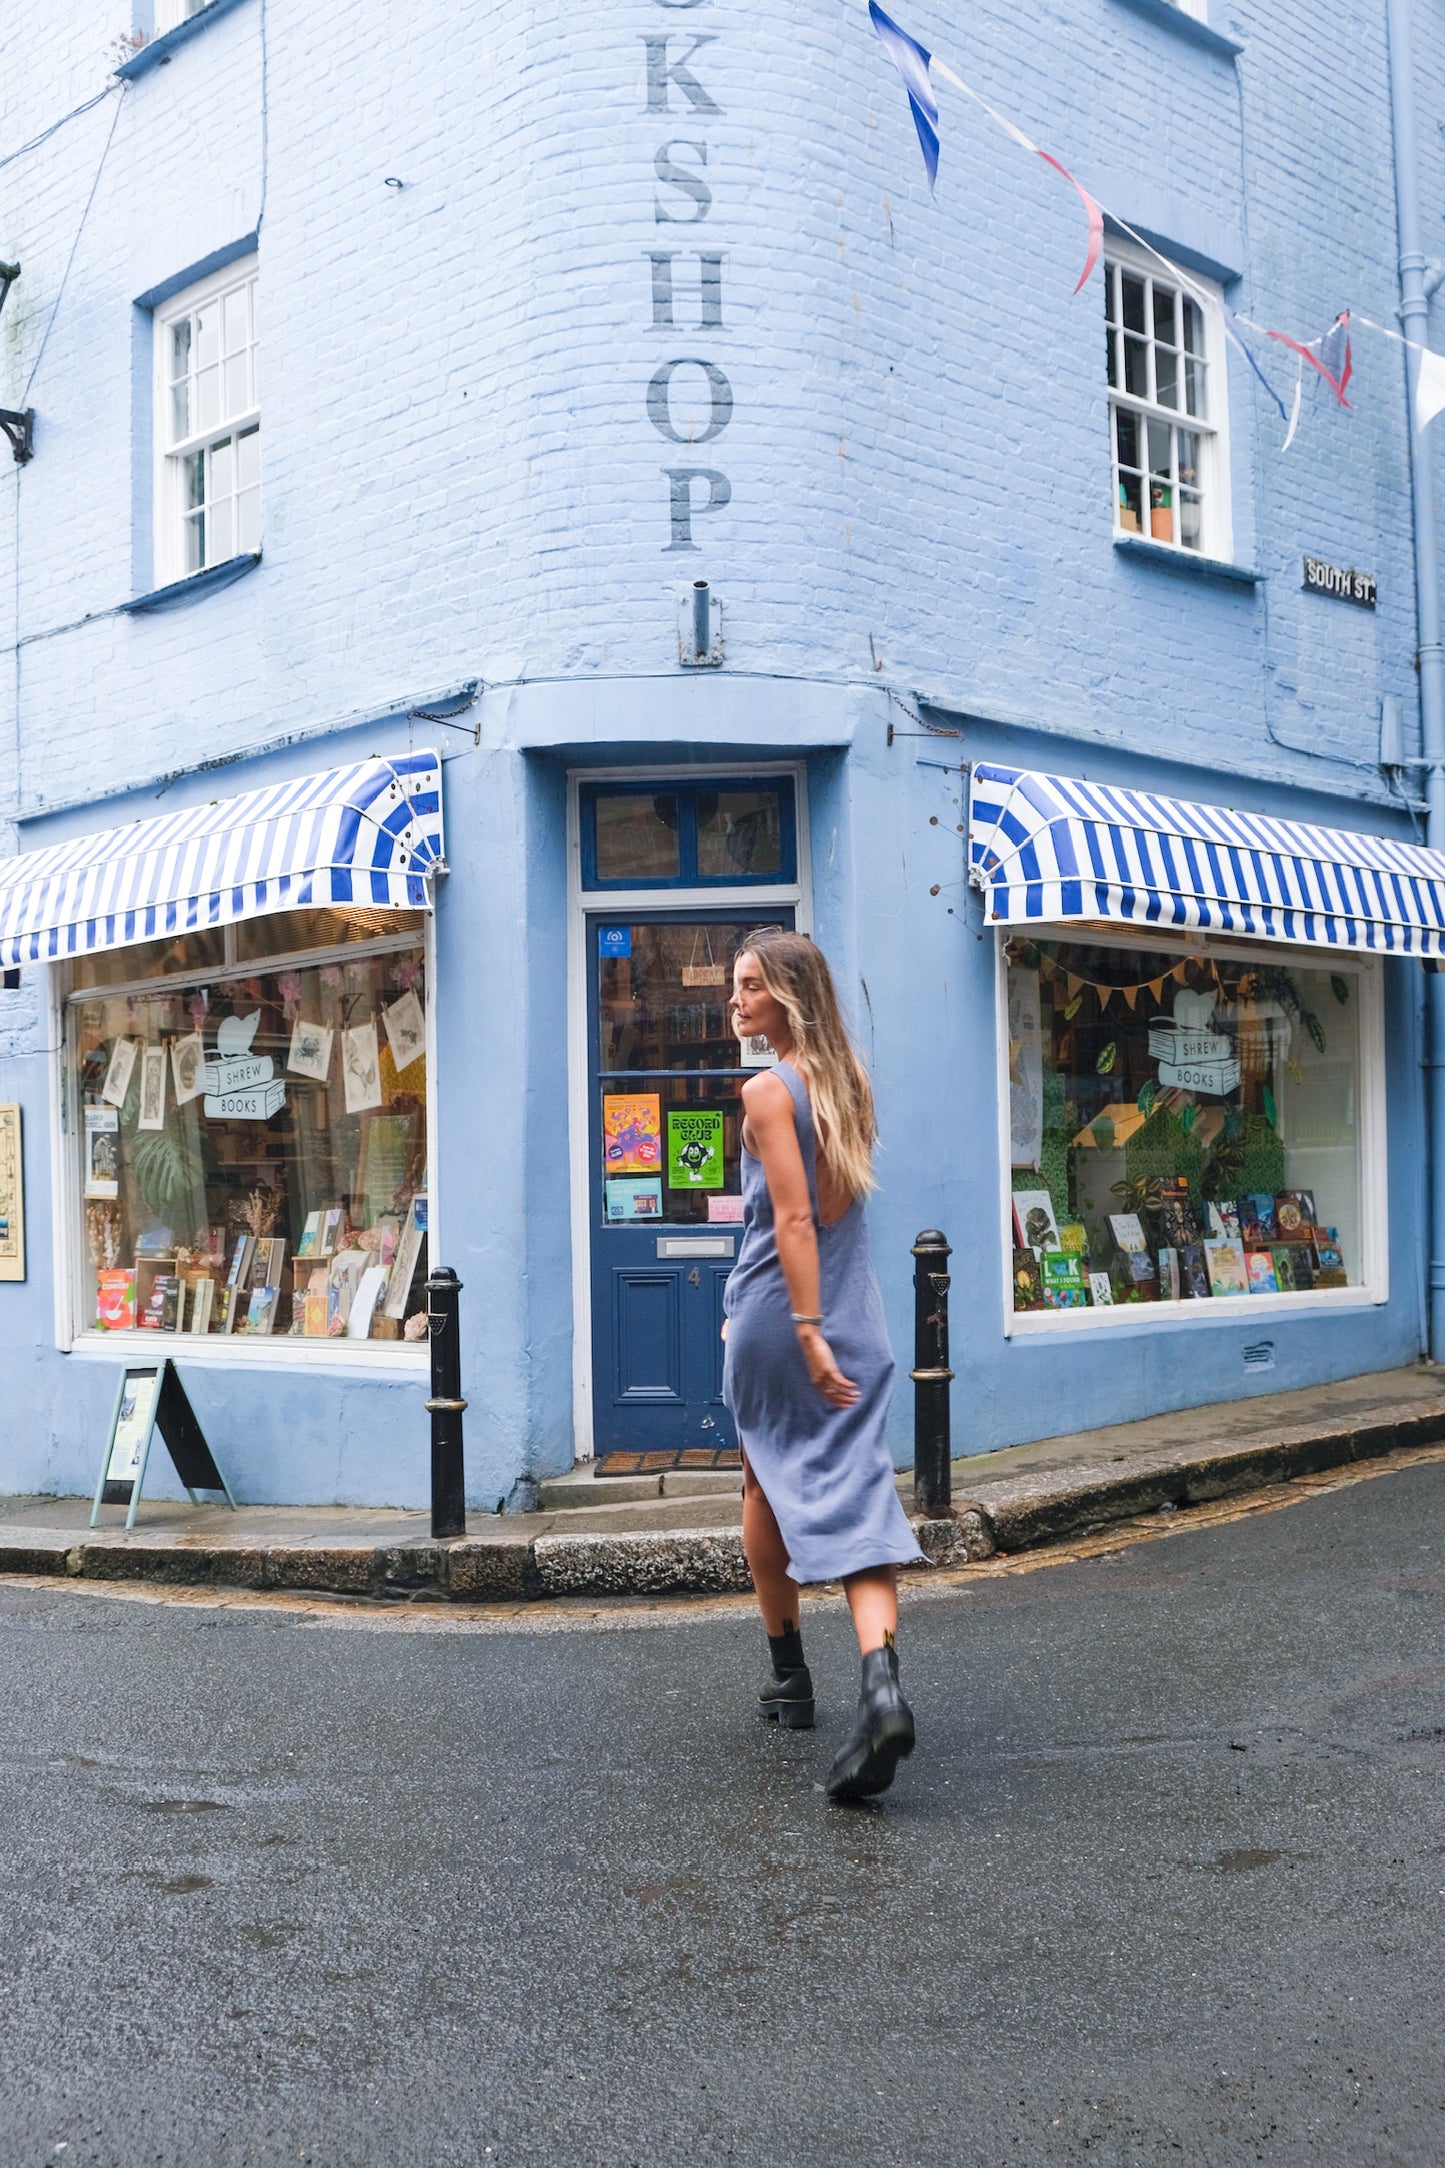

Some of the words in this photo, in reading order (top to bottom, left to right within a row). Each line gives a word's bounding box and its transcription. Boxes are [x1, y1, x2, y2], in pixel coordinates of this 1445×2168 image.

[636, 0, 733, 552] KSHOP
[1307, 561, 1351, 595] SOUTH
[1183, 1041, 1218, 1056] SHREW
[226, 1063, 261, 1085] SHREW
[1177, 1069, 1214, 1087] BOOKS
[221, 1099, 256, 1113] BOOKS
[672, 1118, 720, 1130] RECORD
[681, 1130, 712, 1141] CLUB
[1044, 1258, 1079, 1277] LK
